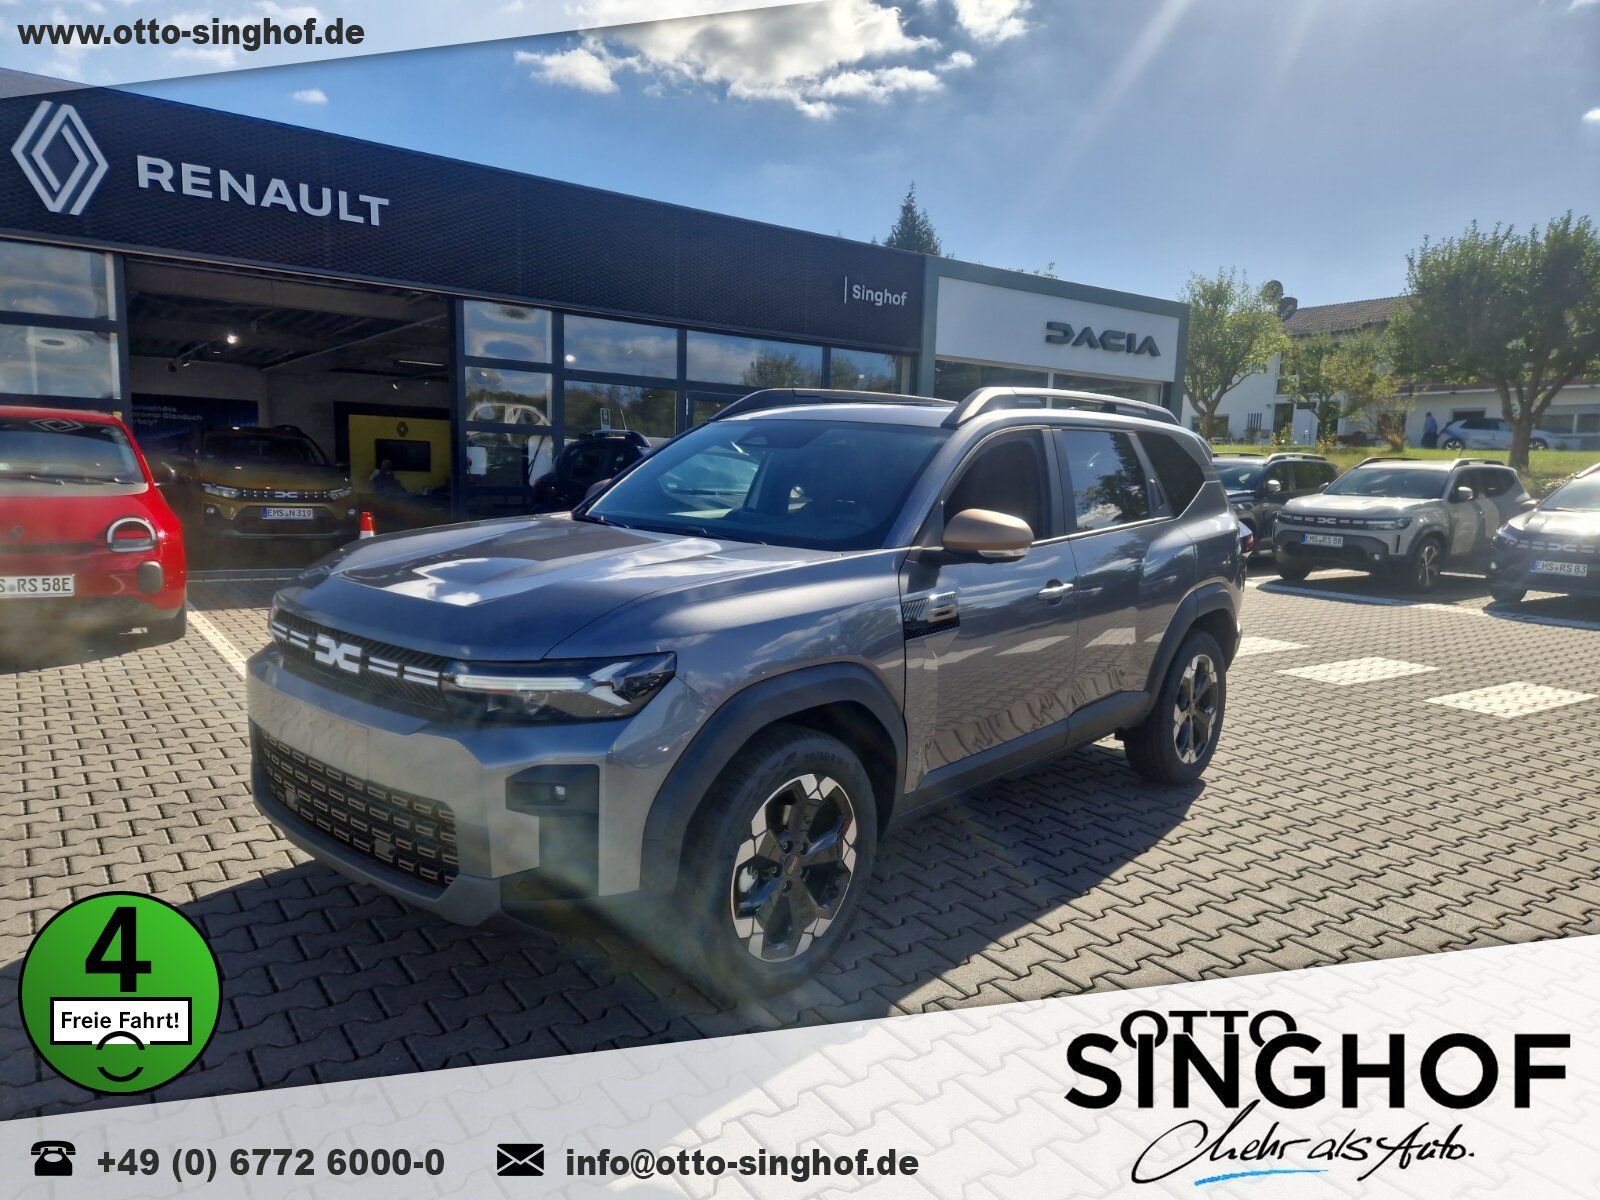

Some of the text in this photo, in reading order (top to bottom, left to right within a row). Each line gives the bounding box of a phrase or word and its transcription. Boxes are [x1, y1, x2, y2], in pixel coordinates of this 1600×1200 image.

[136, 154, 390, 227] RENAULT
[851, 283, 908, 307] Singhof
[1045, 320, 1162, 357] DACIA
[1536, 561, 1554, 571] EMS
[17, 578, 38, 592] RS
[41, 577, 71, 592] 58E
